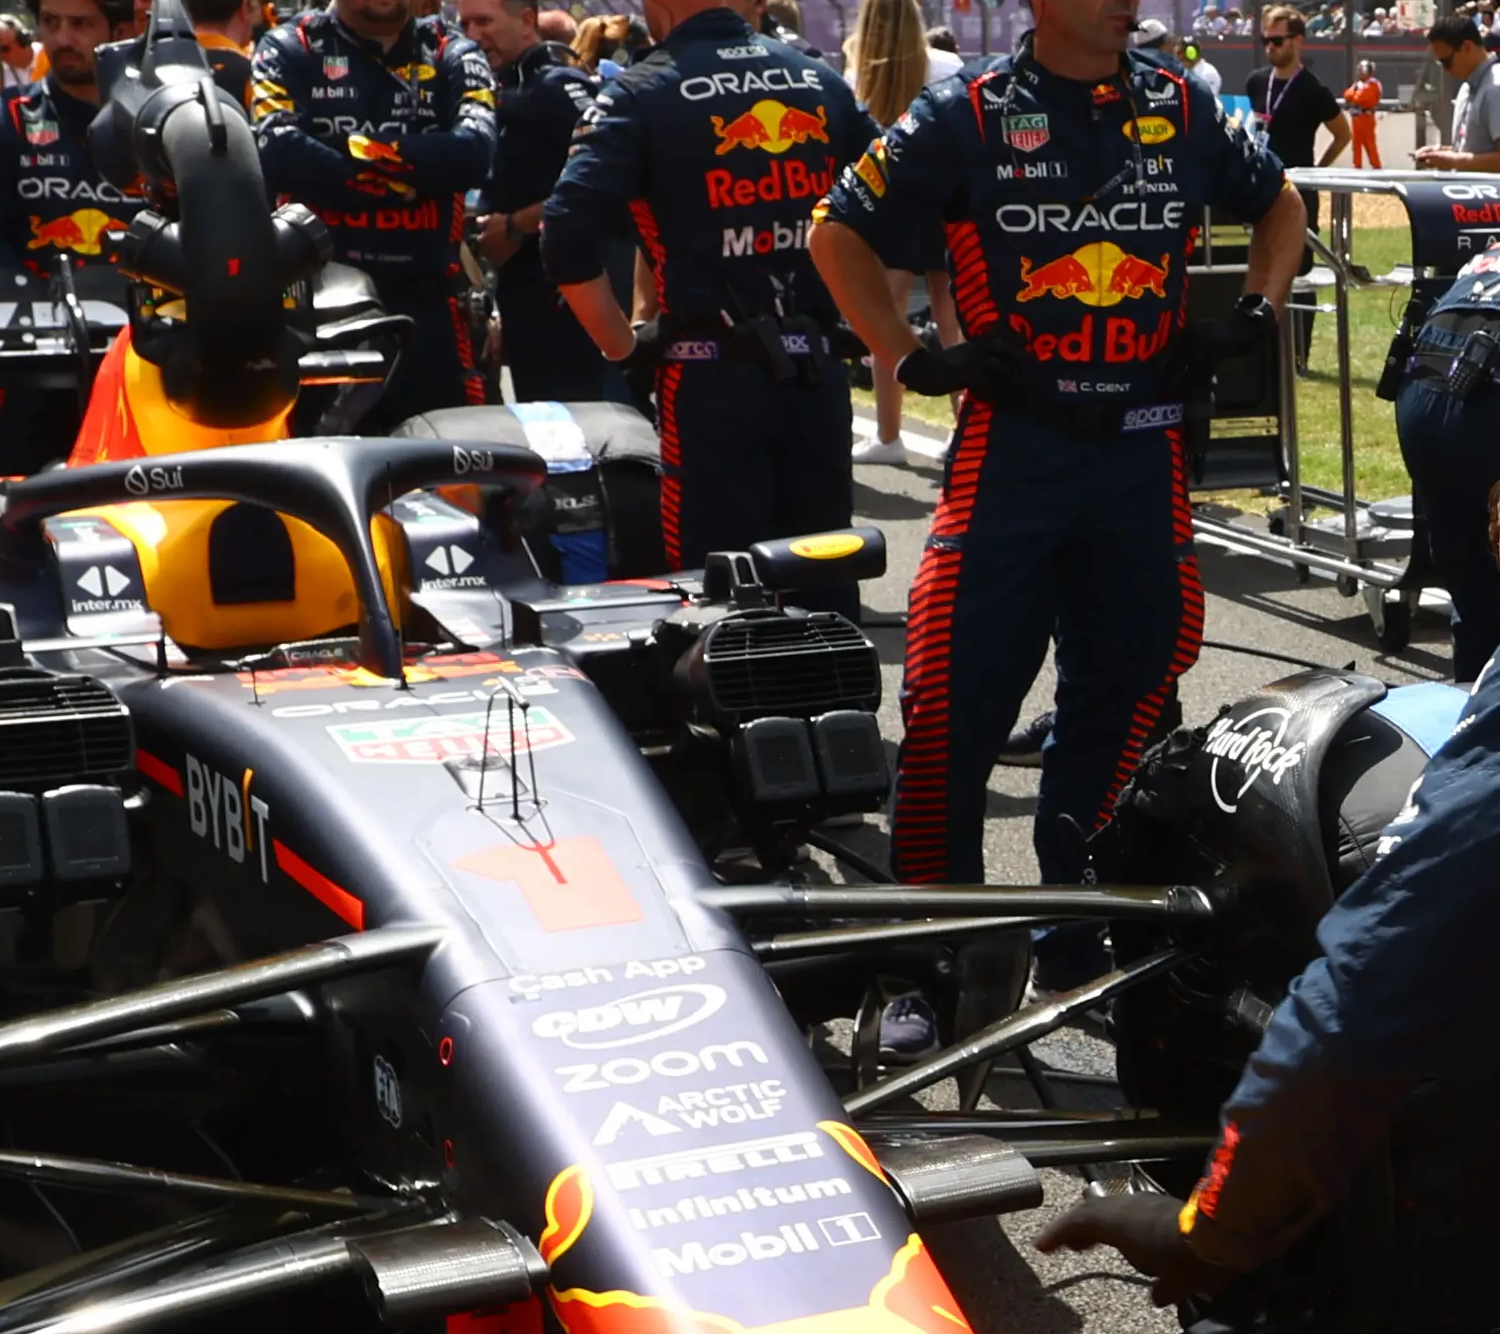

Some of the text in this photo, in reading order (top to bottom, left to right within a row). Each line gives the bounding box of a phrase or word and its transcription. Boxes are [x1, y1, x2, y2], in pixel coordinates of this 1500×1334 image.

[680, 68, 825, 101] ORACLE
[1009, 116, 1045, 129] TAG
[705, 160, 782, 210] Red
[783, 153, 836, 201] Bul
[997, 163, 1048, 180] Mobil
[1122, 181, 1179, 195] HNDA
[996, 201, 1186, 233] ORACLE
[1452, 203, 1493, 224] Red
[152, 465, 185, 491] Sui
[420, 574, 488, 591] inter.mx
[71, 597, 143, 614] inter.mx
[290, 648, 344, 661] ORACLE
[272, 675, 561, 718] ORACLE
[186, 752, 270, 884] BYBIT
[508, 953, 706, 996] Cash App
[532, 994, 683, 1039] CDW
[657, 1079, 787, 1114] ARCTIC
[679, 1098, 783, 1130] WOLF
[604, 1131, 825, 1192] PIRELLI
[650, 1222, 820, 1281] Mobil
